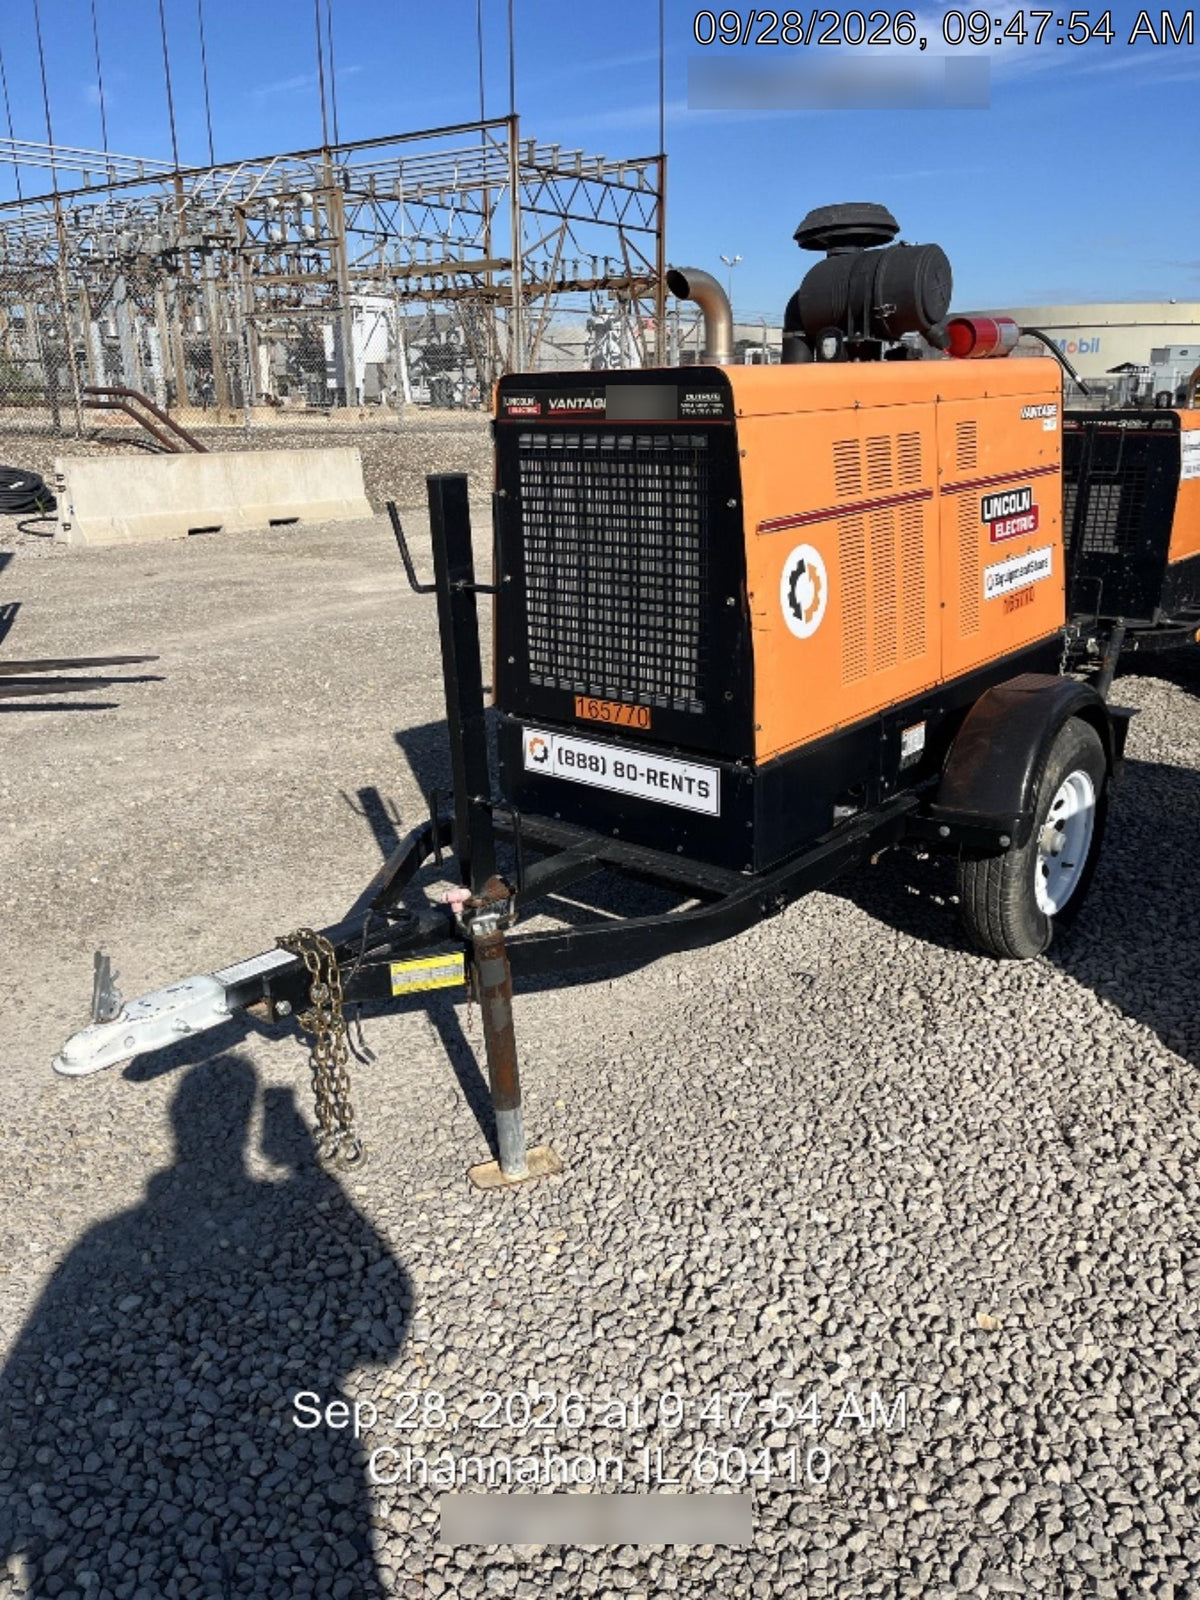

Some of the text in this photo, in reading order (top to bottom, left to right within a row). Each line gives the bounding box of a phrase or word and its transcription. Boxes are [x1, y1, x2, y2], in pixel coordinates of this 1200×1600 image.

[1050, 338, 1100, 354] Mobil
[983, 489, 1031, 520] LINCOLN
[995, 514, 1036, 539] ELECTRIC
[576, 698, 650, 728] 165770
[557, 746, 711, 800] (888) 80-RENTS
